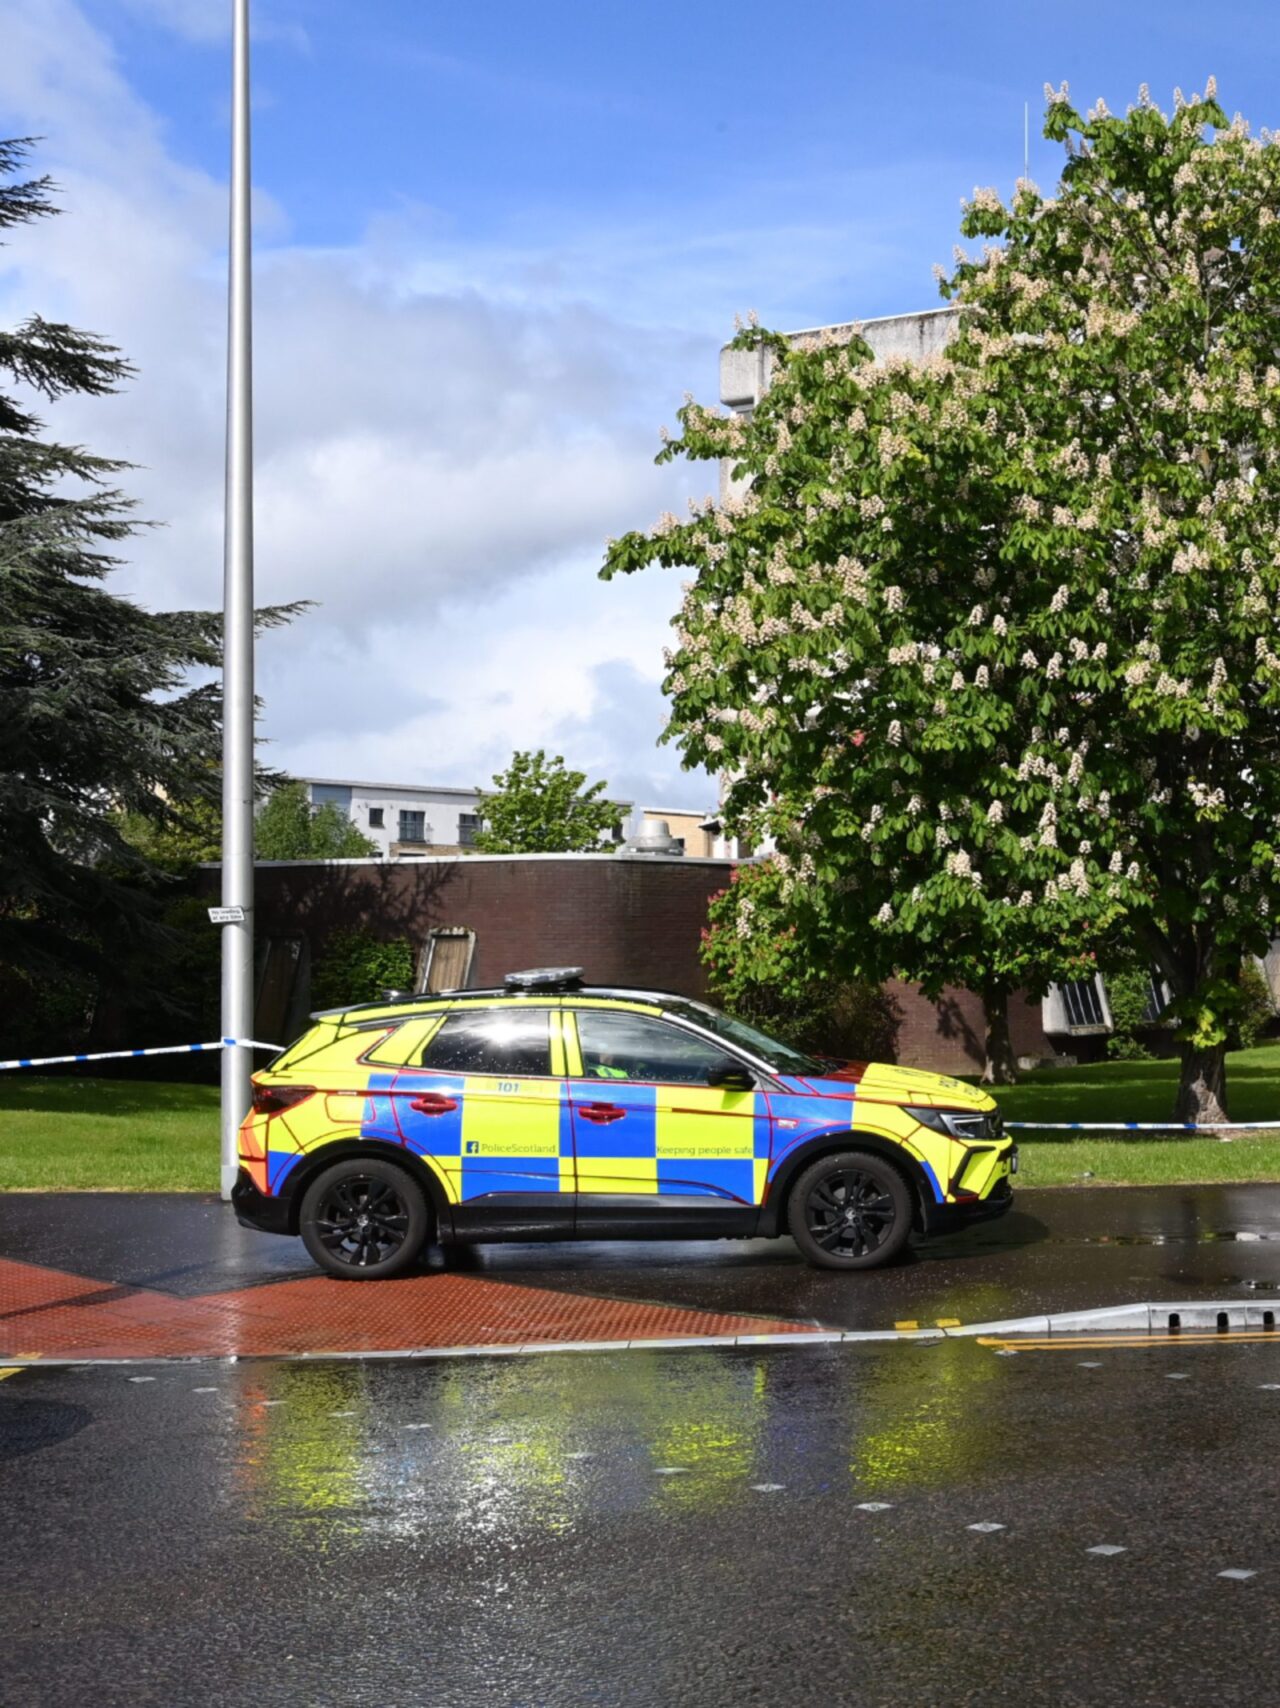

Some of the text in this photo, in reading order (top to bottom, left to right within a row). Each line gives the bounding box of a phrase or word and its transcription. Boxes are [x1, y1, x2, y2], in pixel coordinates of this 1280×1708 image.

[498, 1082, 520, 1092] 101
[481, 1143, 556, 1153] PoliceScotland
[656, 1146, 753, 1156] Keeping people safe
